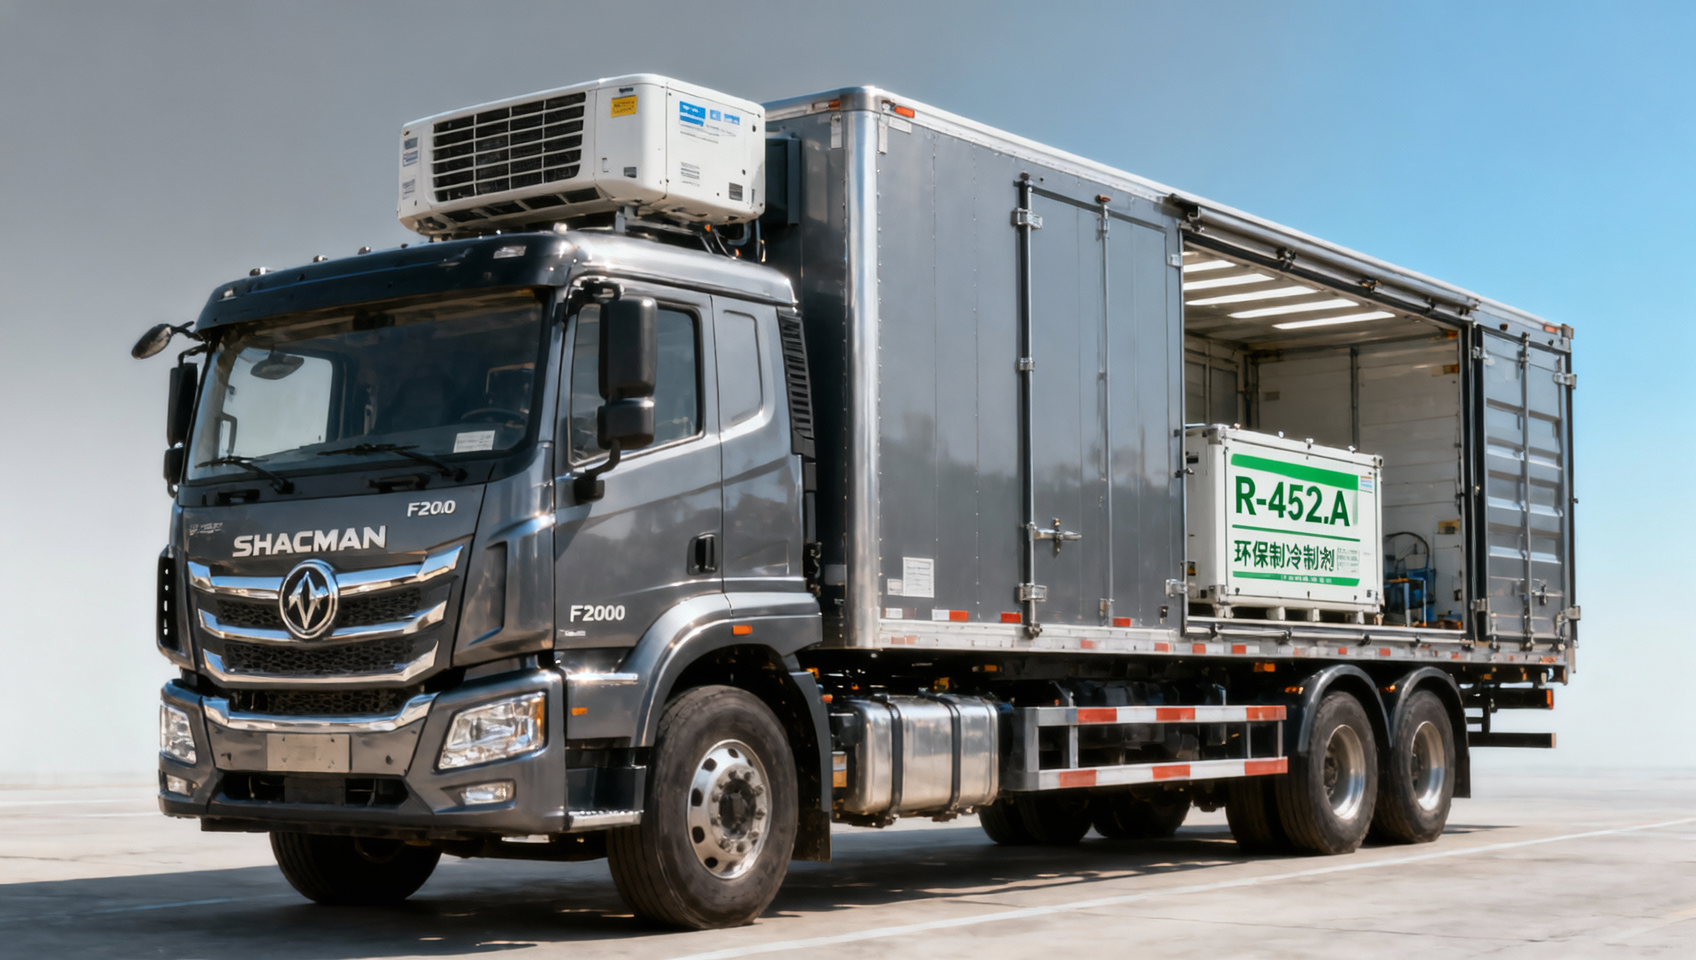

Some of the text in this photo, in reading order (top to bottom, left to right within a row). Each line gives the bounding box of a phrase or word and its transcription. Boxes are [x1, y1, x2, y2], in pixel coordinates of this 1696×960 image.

[1235, 475, 1350, 527] R-452.A
[232, 525, 387, 558] SHACMAN
[570, 604, 626, 623] F2000
